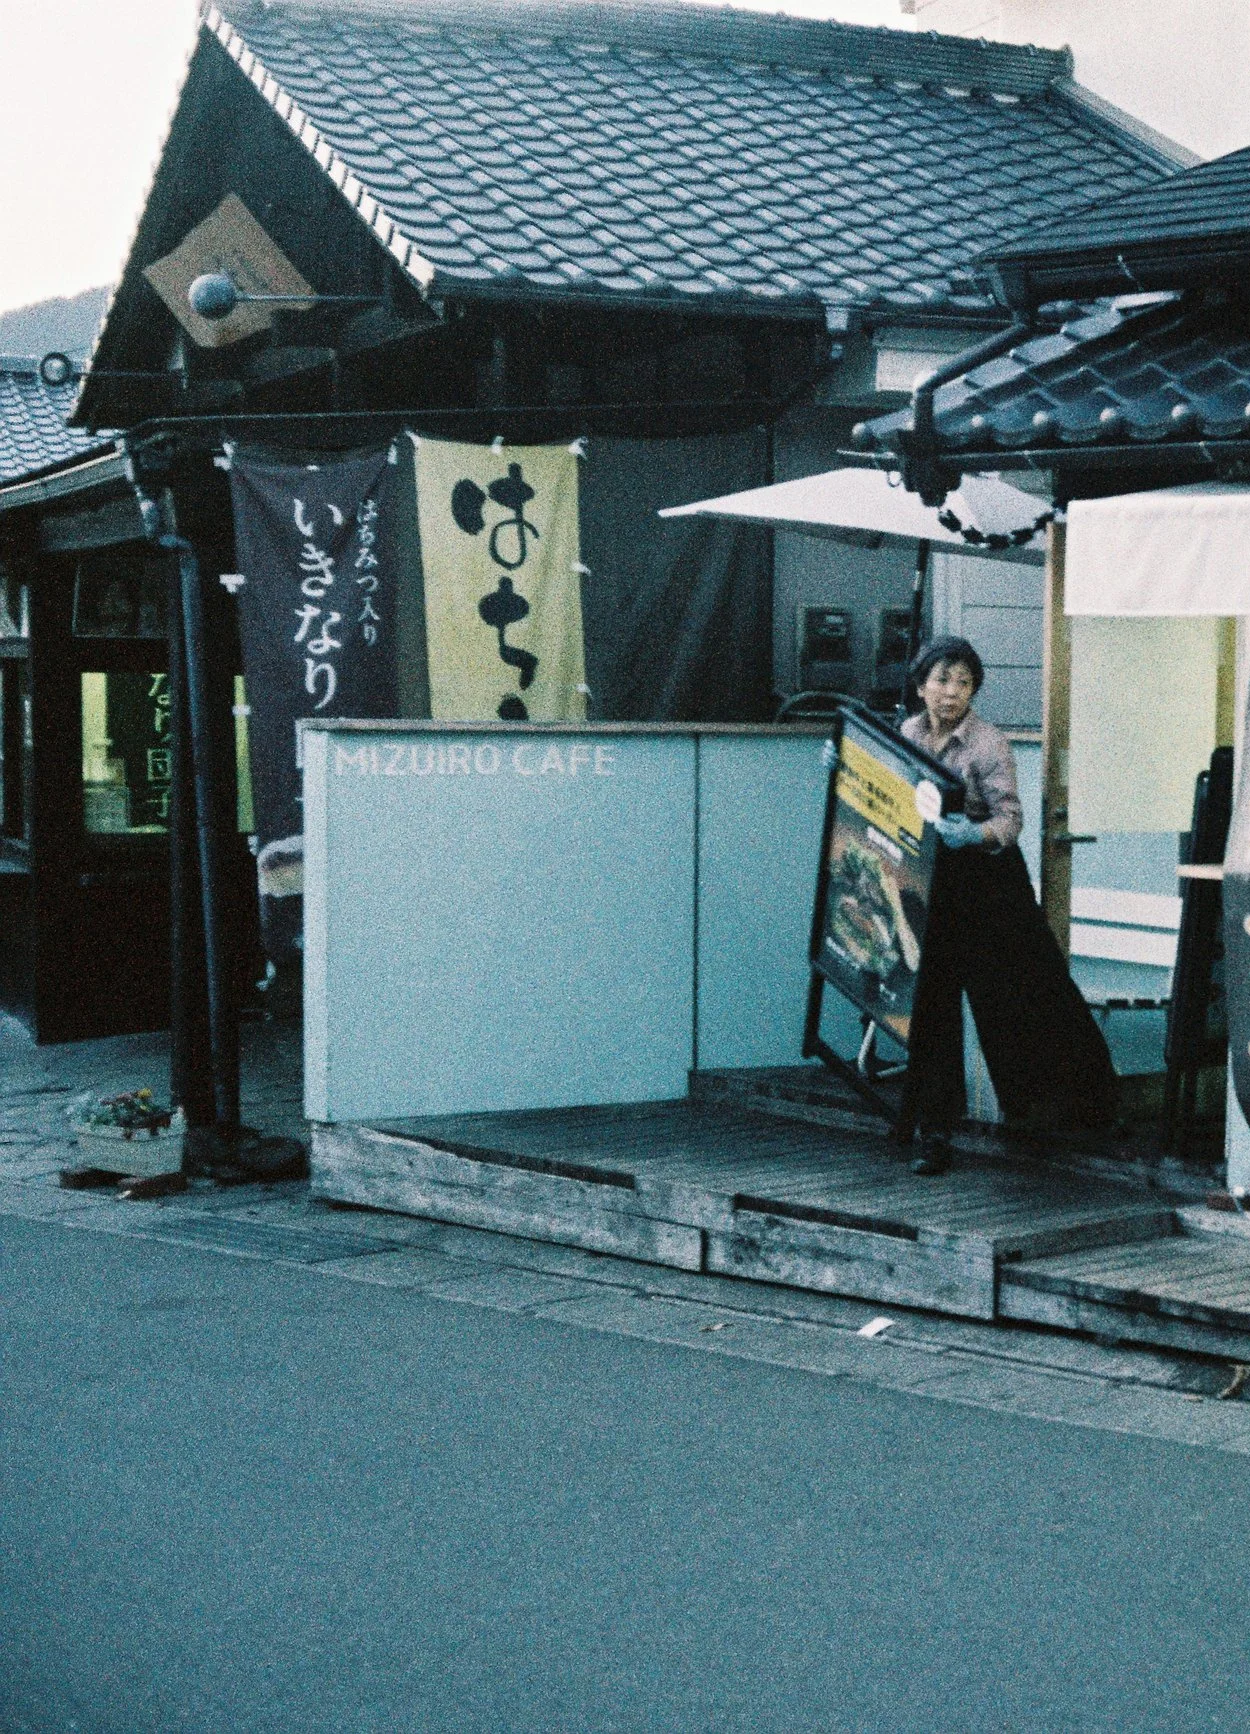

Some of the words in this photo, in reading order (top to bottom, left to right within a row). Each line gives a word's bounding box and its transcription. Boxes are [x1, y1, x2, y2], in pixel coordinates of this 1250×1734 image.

[292, 498, 344, 710] いきなり
[354, 499, 379, 647] はちみつ入り
[334, 744, 499, 777] MIZUIRO
[510, 743, 616, 777] CAFE
